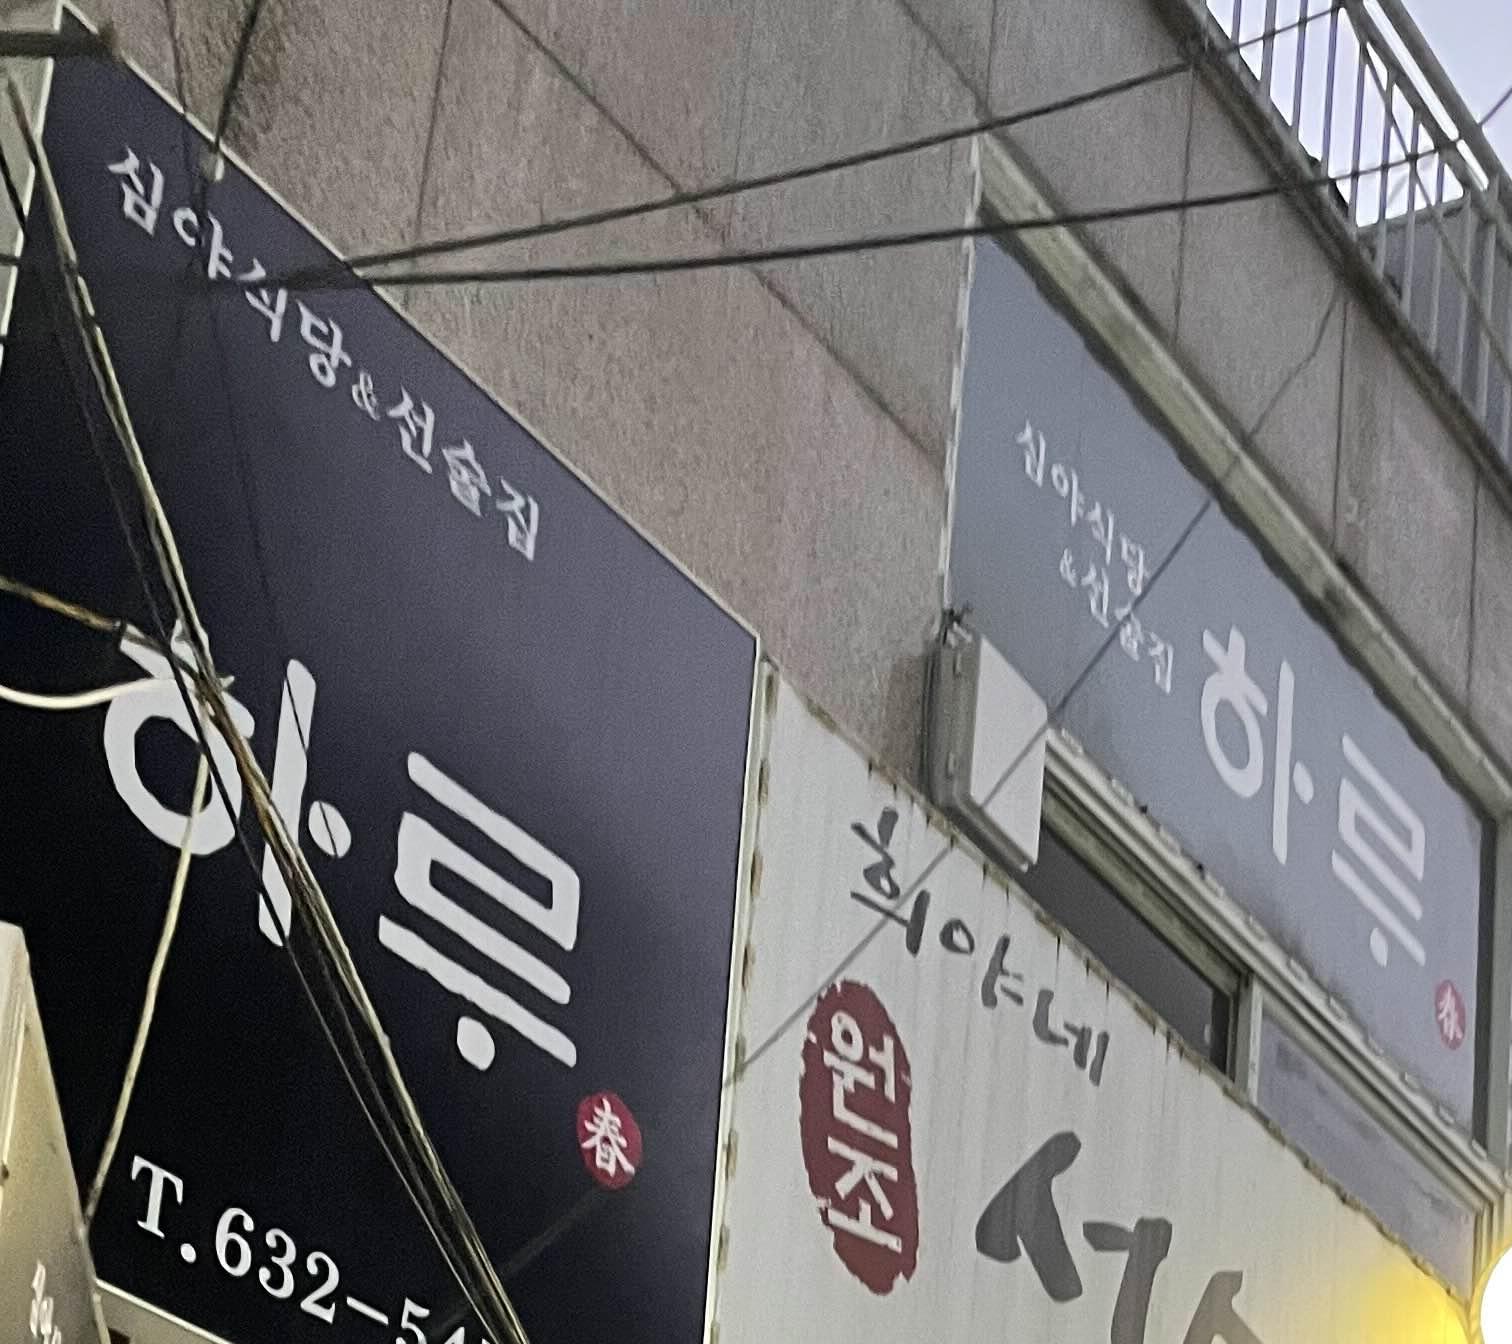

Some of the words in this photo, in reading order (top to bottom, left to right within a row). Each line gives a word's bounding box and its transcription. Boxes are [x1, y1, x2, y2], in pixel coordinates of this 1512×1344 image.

[107, 145, 539, 562] 심야식당&선술집
[104, 620, 580, 1070] 하루
[849, 807, 1110, 1087] 희야네
[1200, 624, 1427, 968] 하루
[821, 1009, 904, 1254] 원조
